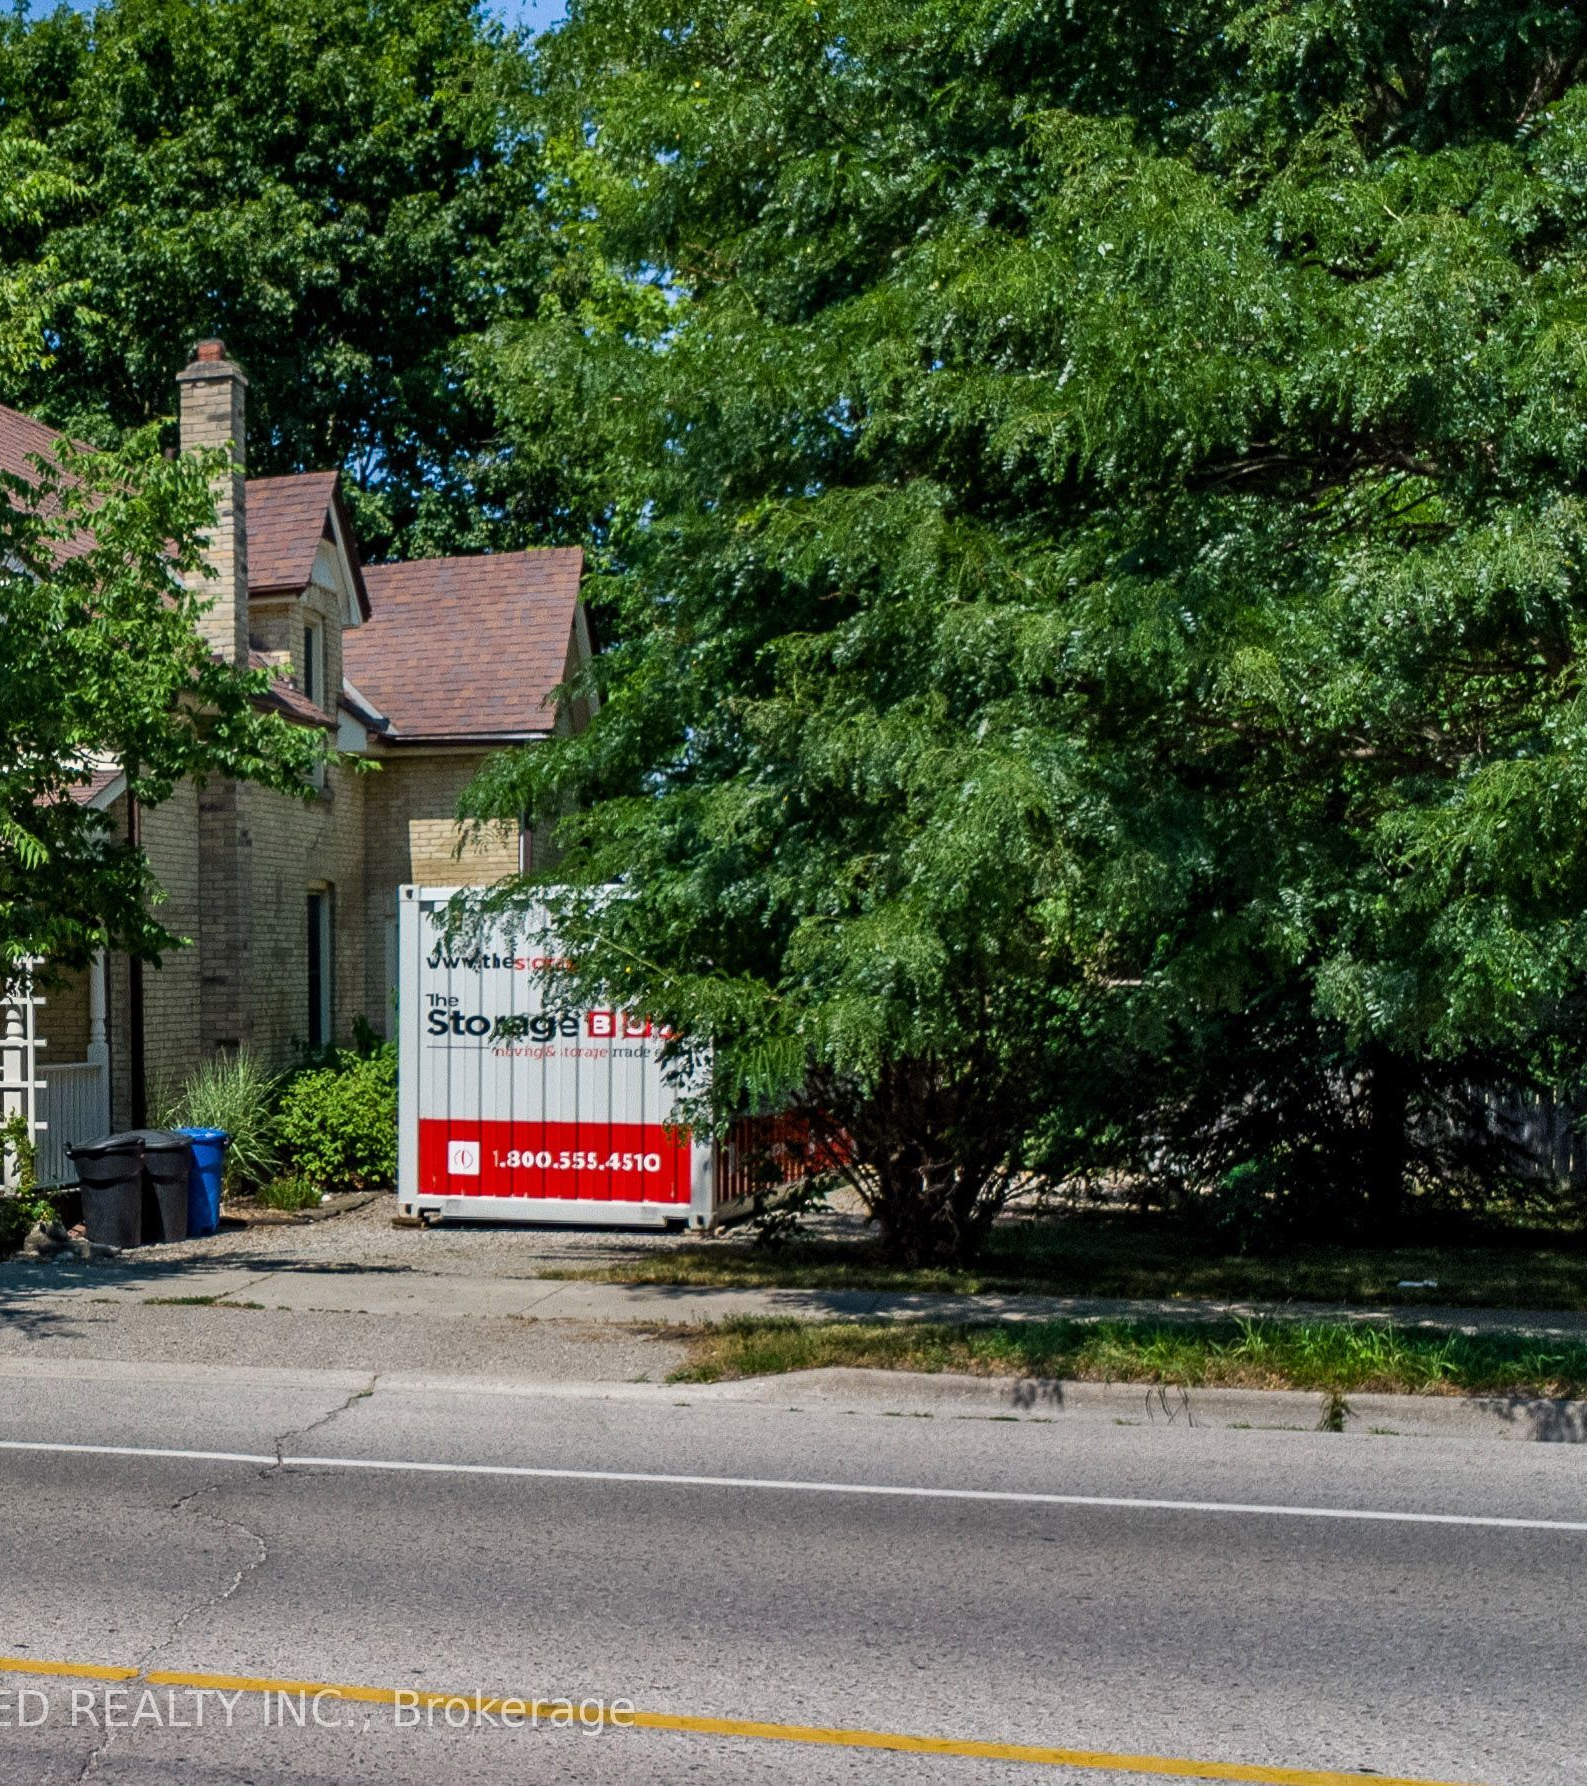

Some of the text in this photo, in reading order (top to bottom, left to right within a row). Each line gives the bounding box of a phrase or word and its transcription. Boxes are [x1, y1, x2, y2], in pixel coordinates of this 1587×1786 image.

[426, 993, 459, 1007] The
[426, 1009, 580, 1042] Storage
[493, 1150, 661, 1172] 1.800.555.4510
